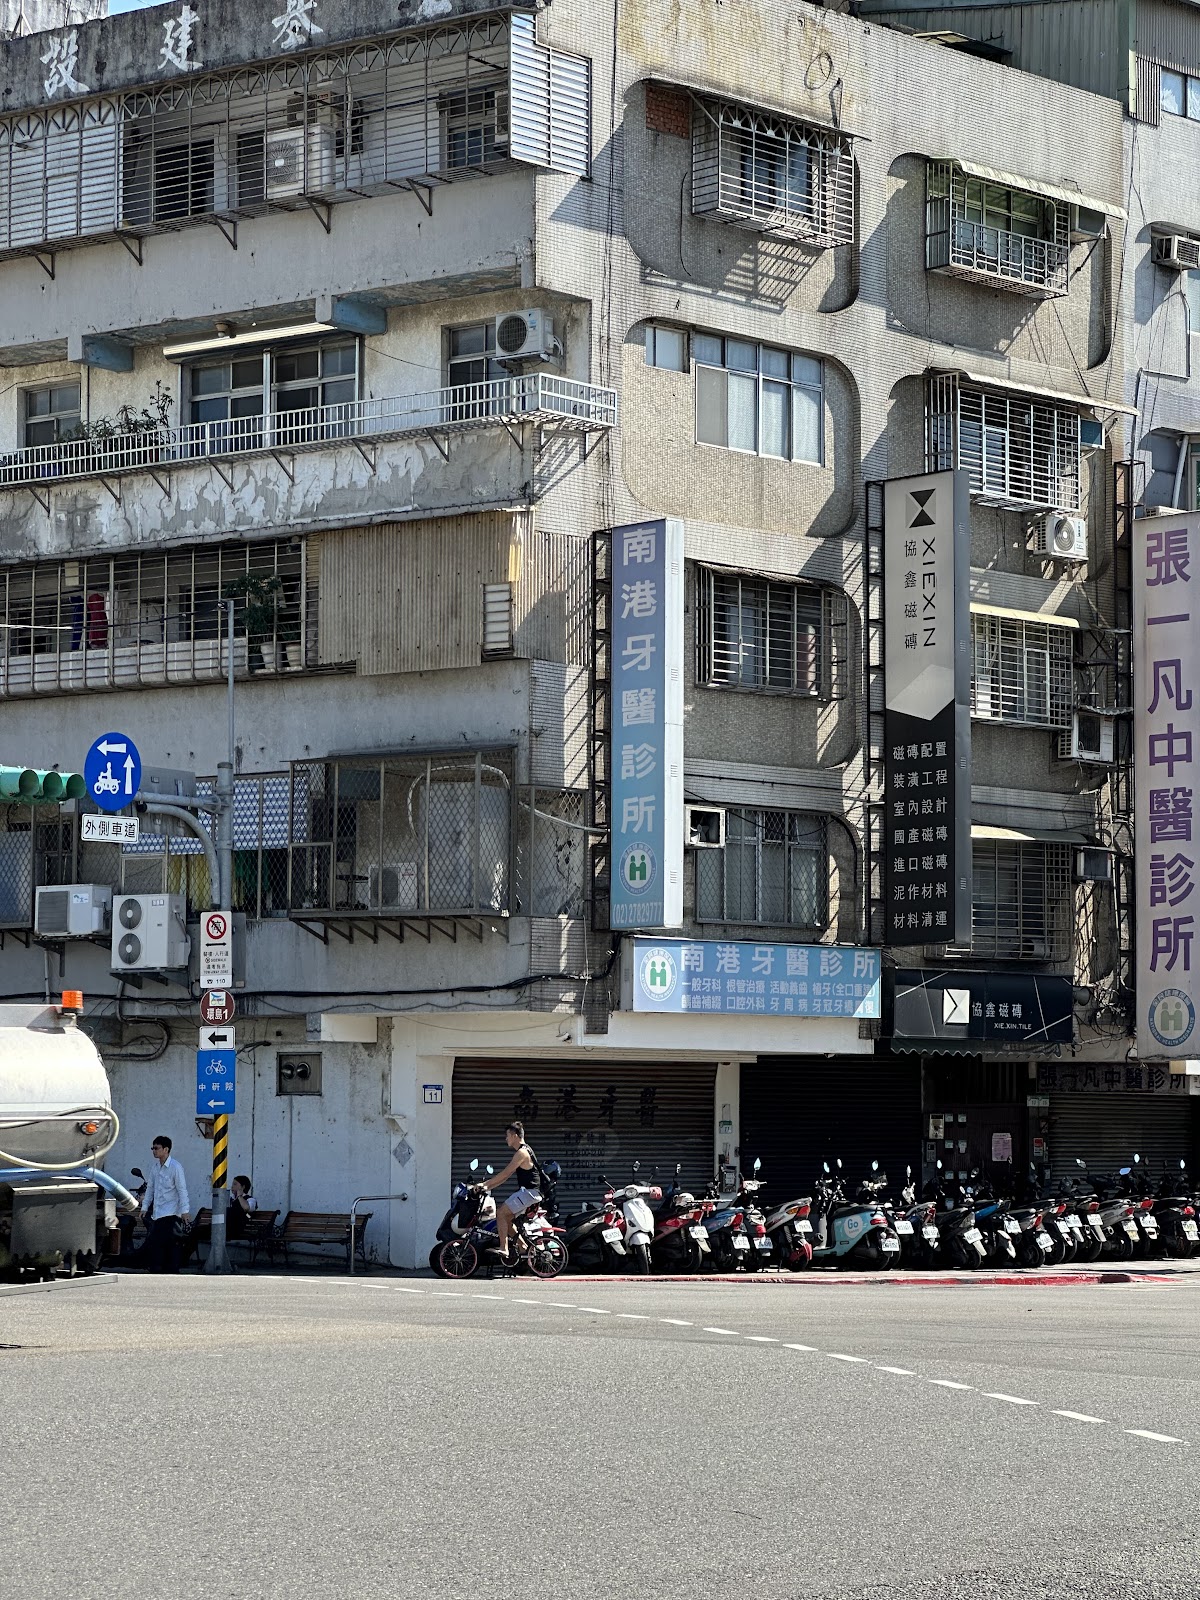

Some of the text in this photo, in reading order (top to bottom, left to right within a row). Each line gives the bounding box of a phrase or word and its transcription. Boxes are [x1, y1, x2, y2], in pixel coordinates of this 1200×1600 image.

[904, 540, 917, 650] 協鑫磁磚
[922, 536, 936, 647] XIEXIN
[620, 528, 657, 834] 南港牙醫診所
[893, 741, 947, 761] 磁磚配置
[1146, 528, 1195, 972] 張一凡中醫診所
[893, 769, 948, 789] 裝潢工程
[893, 797, 948, 817] 室內設計
[85, 819, 136, 838] 外側車道
[894, 825, 948, 845] 國產磁磚
[893, 853, 948, 873] 進口磁磚
[893, 881, 948, 901] 泥作材料
[893, 910, 948, 929] 材料清運
[681, 944, 875, 978] 南港牙醫診所
[682, 978, 721, 992] 一般牙科
[726, 979, 765, 994] 根管治療
[727, 996, 765, 1010] 口腔外科
[972, 1001, 1022, 1018] 協鑫磁磚
[206, 1008, 229, 1020] 環島1
[198, 1082, 234, 1092] 中研院
[429, 1091, 438, 1101] 11
[847, 1219, 859, 1229] Go
